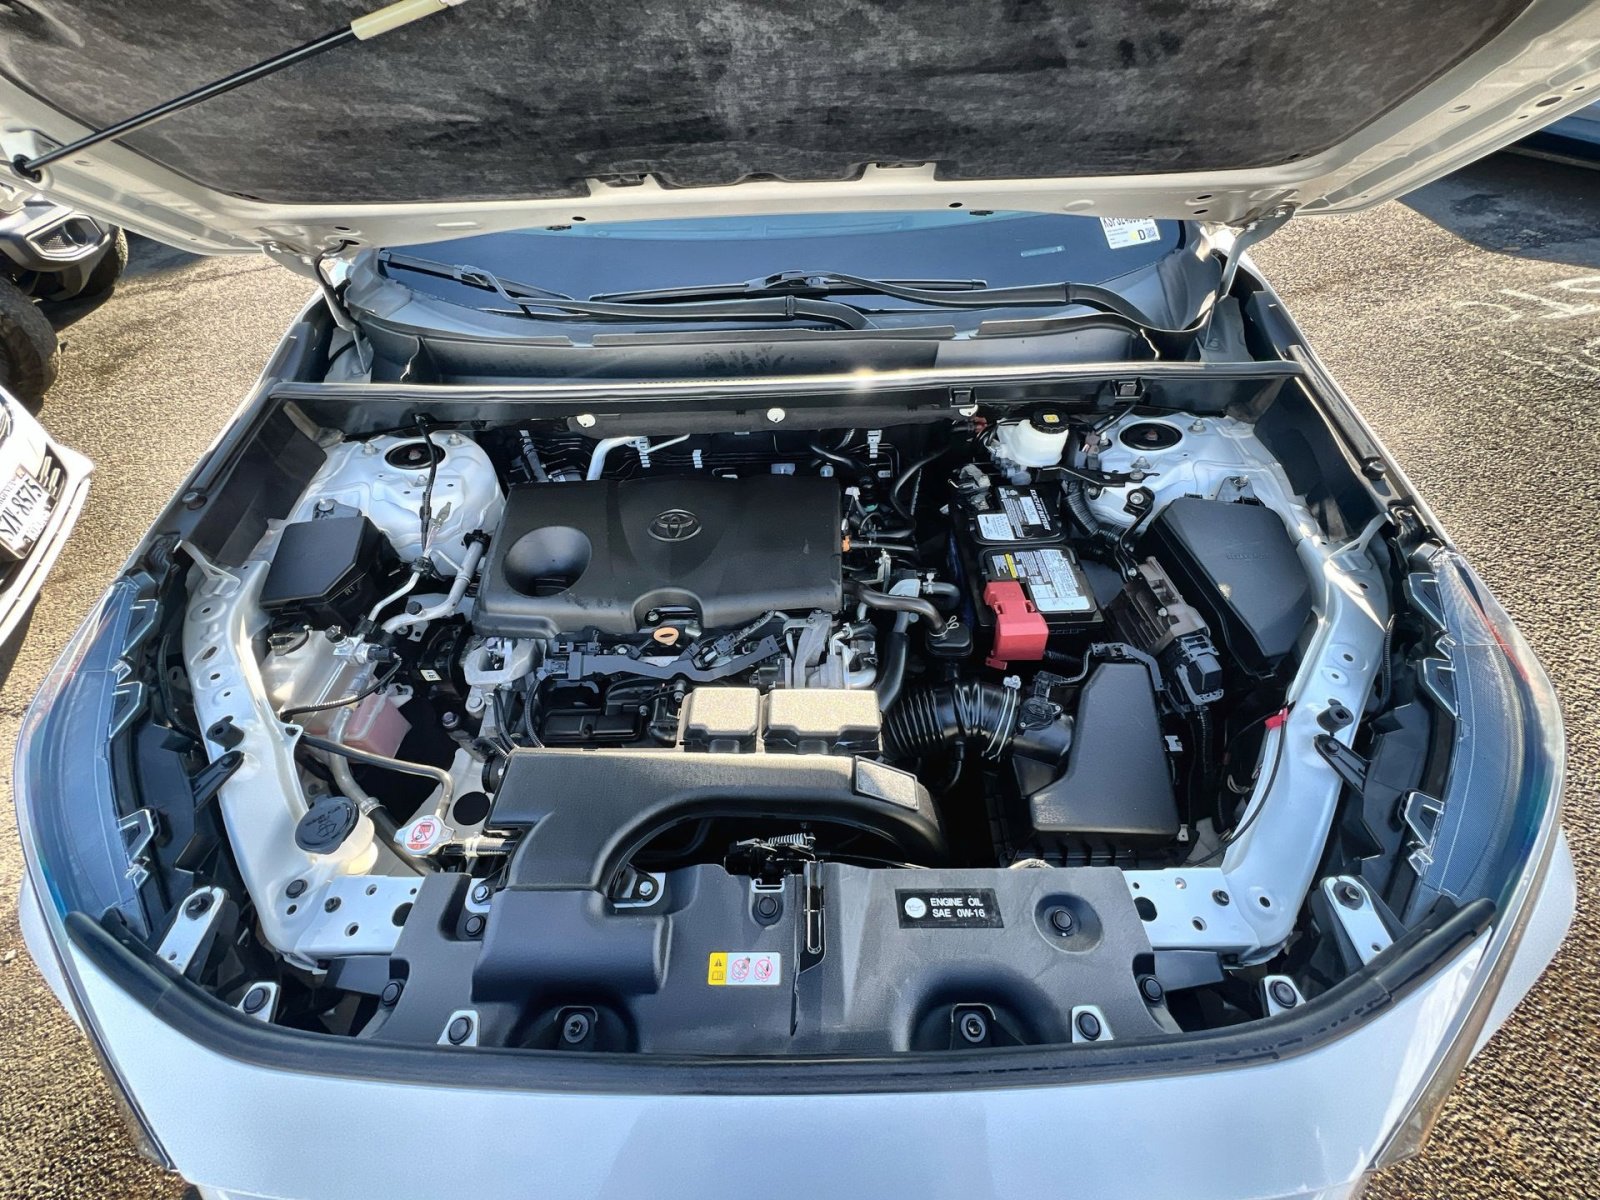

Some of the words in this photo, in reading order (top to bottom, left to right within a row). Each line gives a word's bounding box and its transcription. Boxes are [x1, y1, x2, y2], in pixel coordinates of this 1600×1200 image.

[1137, 229, 1146, 240] D
[930, 897, 963, 906] ENGINE
[967, 897, 983, 906] OIL
[932, 909, 951, 917] SAE
[957, 909, 985, 917] 0W-16
